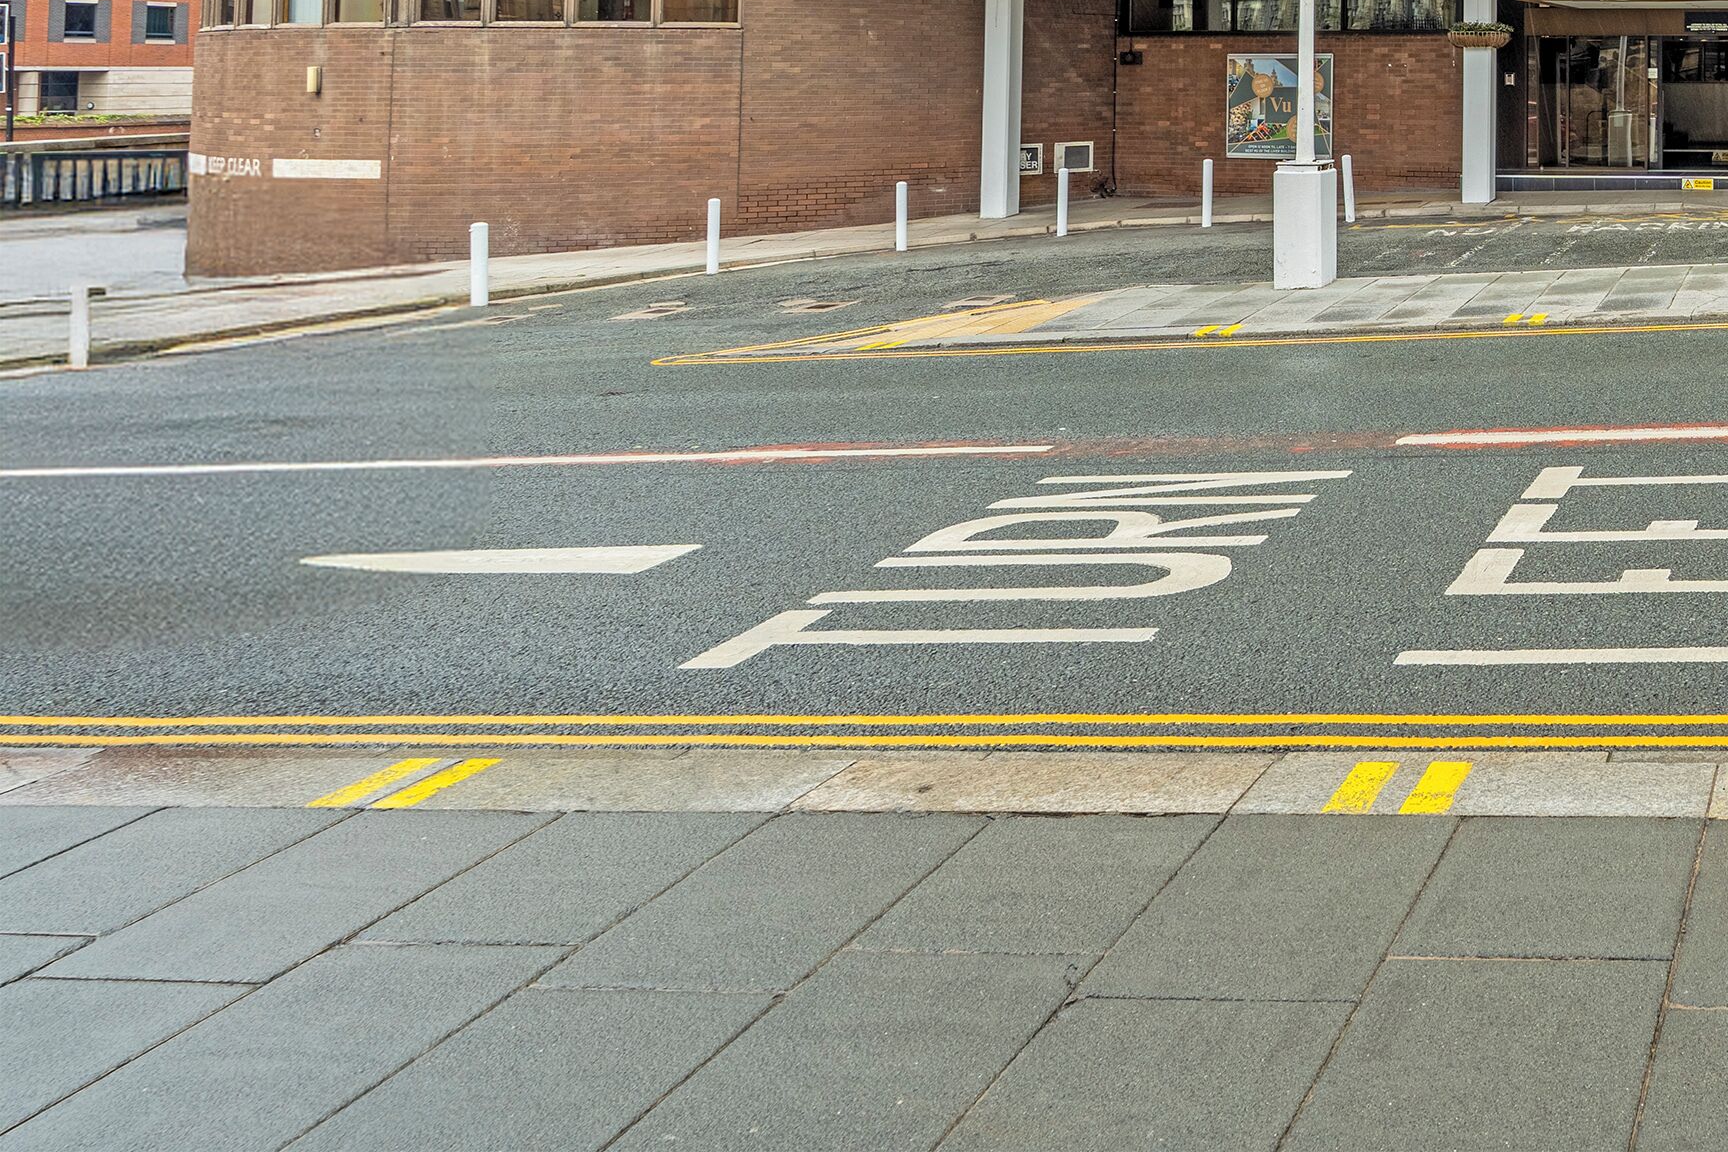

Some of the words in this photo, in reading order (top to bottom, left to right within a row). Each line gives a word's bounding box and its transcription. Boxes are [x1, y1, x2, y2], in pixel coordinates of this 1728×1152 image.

[1270, 96, 1292, 113] Vu
[227, 157, 262, 177] CLEAR
[677, 469, 1353, 669] TURN
